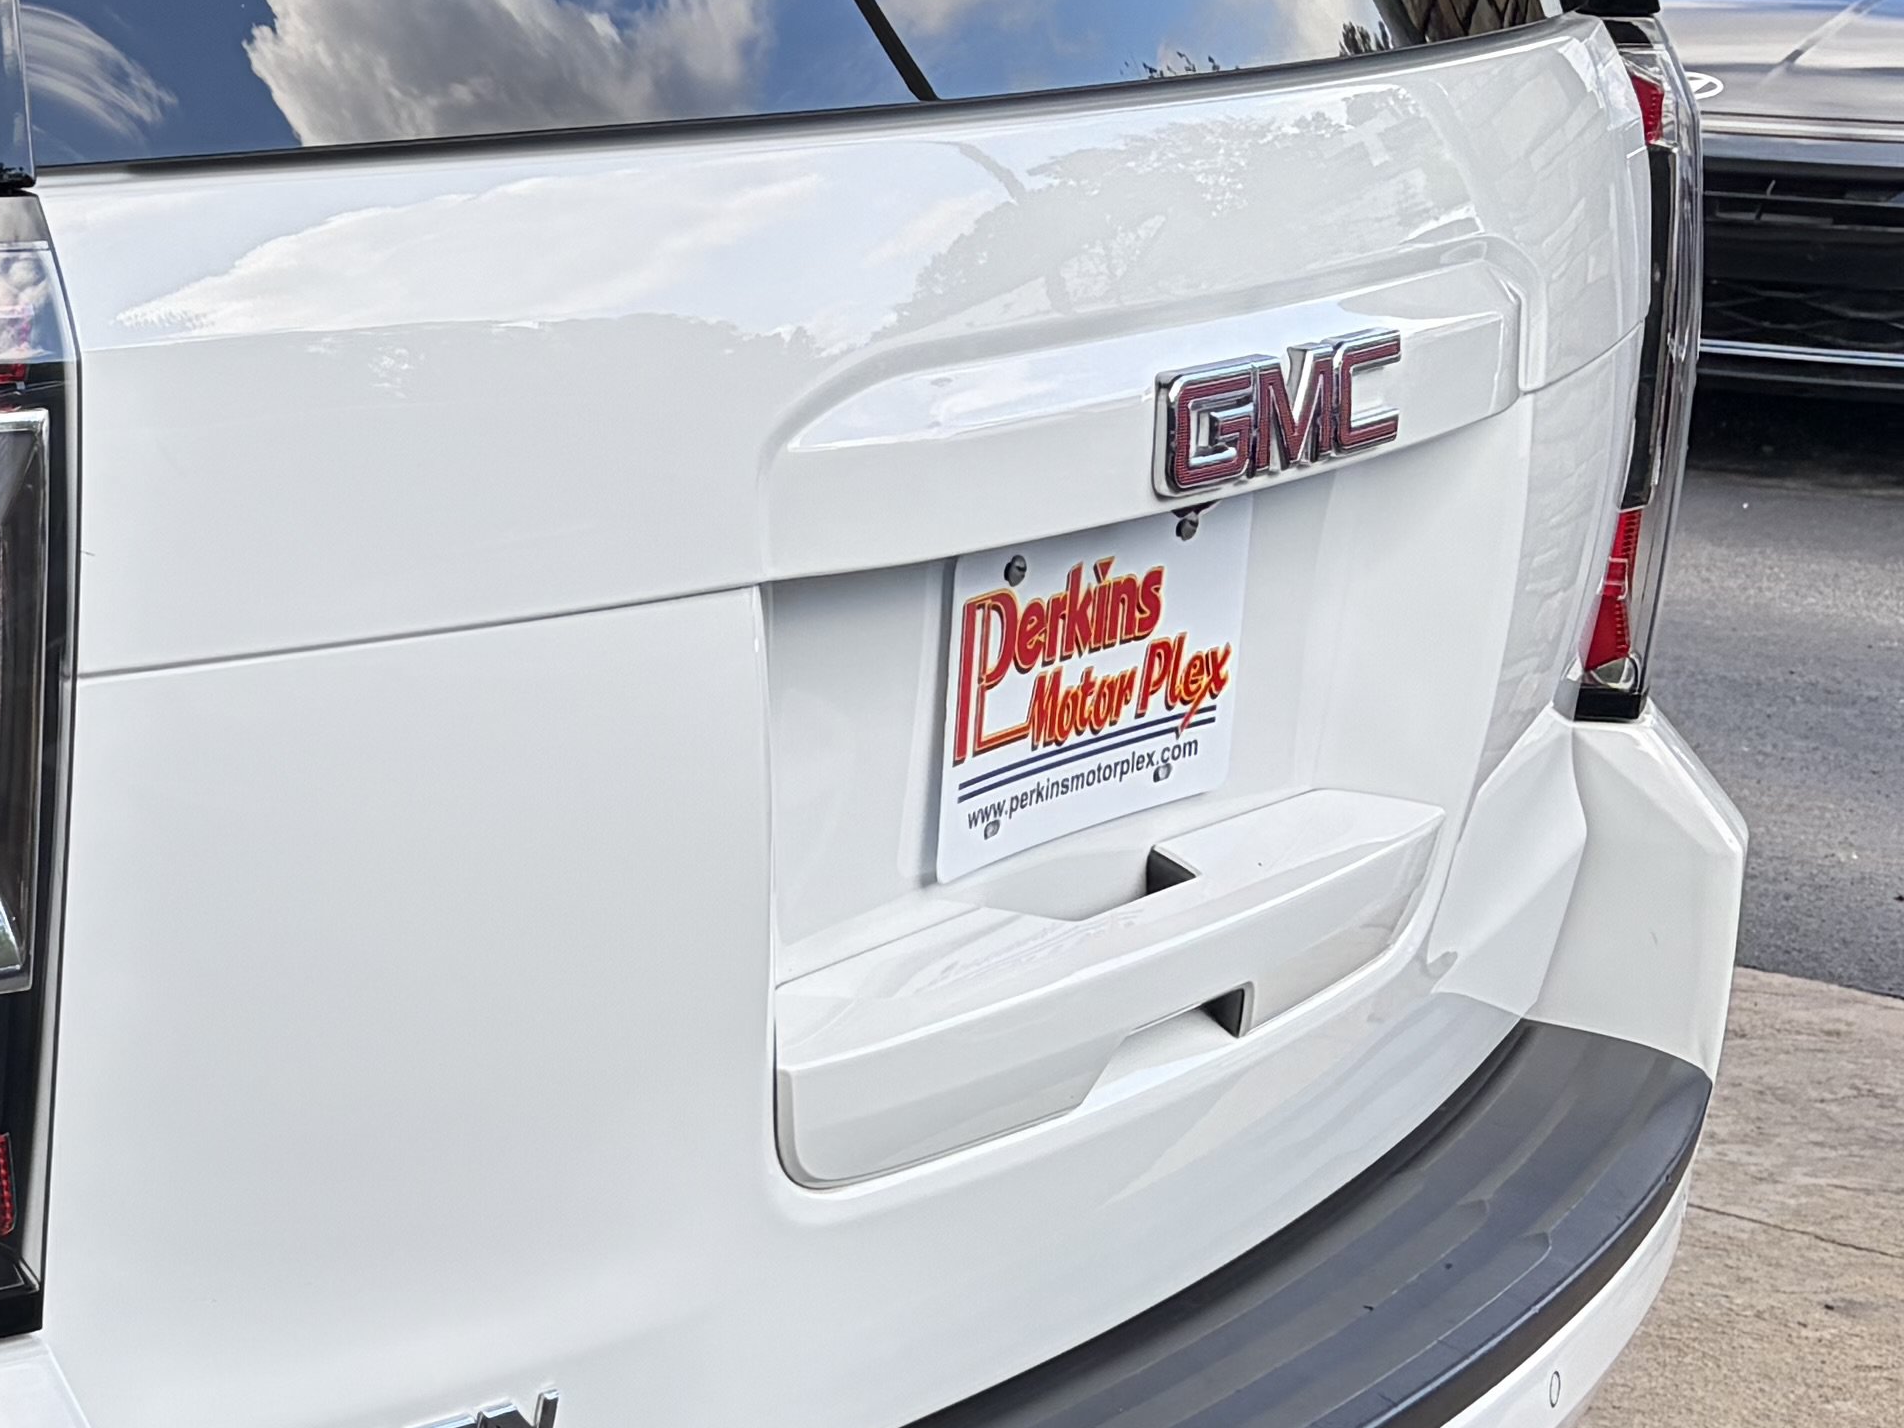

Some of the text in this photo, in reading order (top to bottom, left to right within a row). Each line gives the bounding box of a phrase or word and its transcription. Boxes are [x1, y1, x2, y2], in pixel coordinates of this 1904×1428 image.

[1152, 328, 1401, 498] GMC
[953, 558, 1165, 767] Perkins
[967, 736, 1200, 830] www.perkinsmotorplex.com
